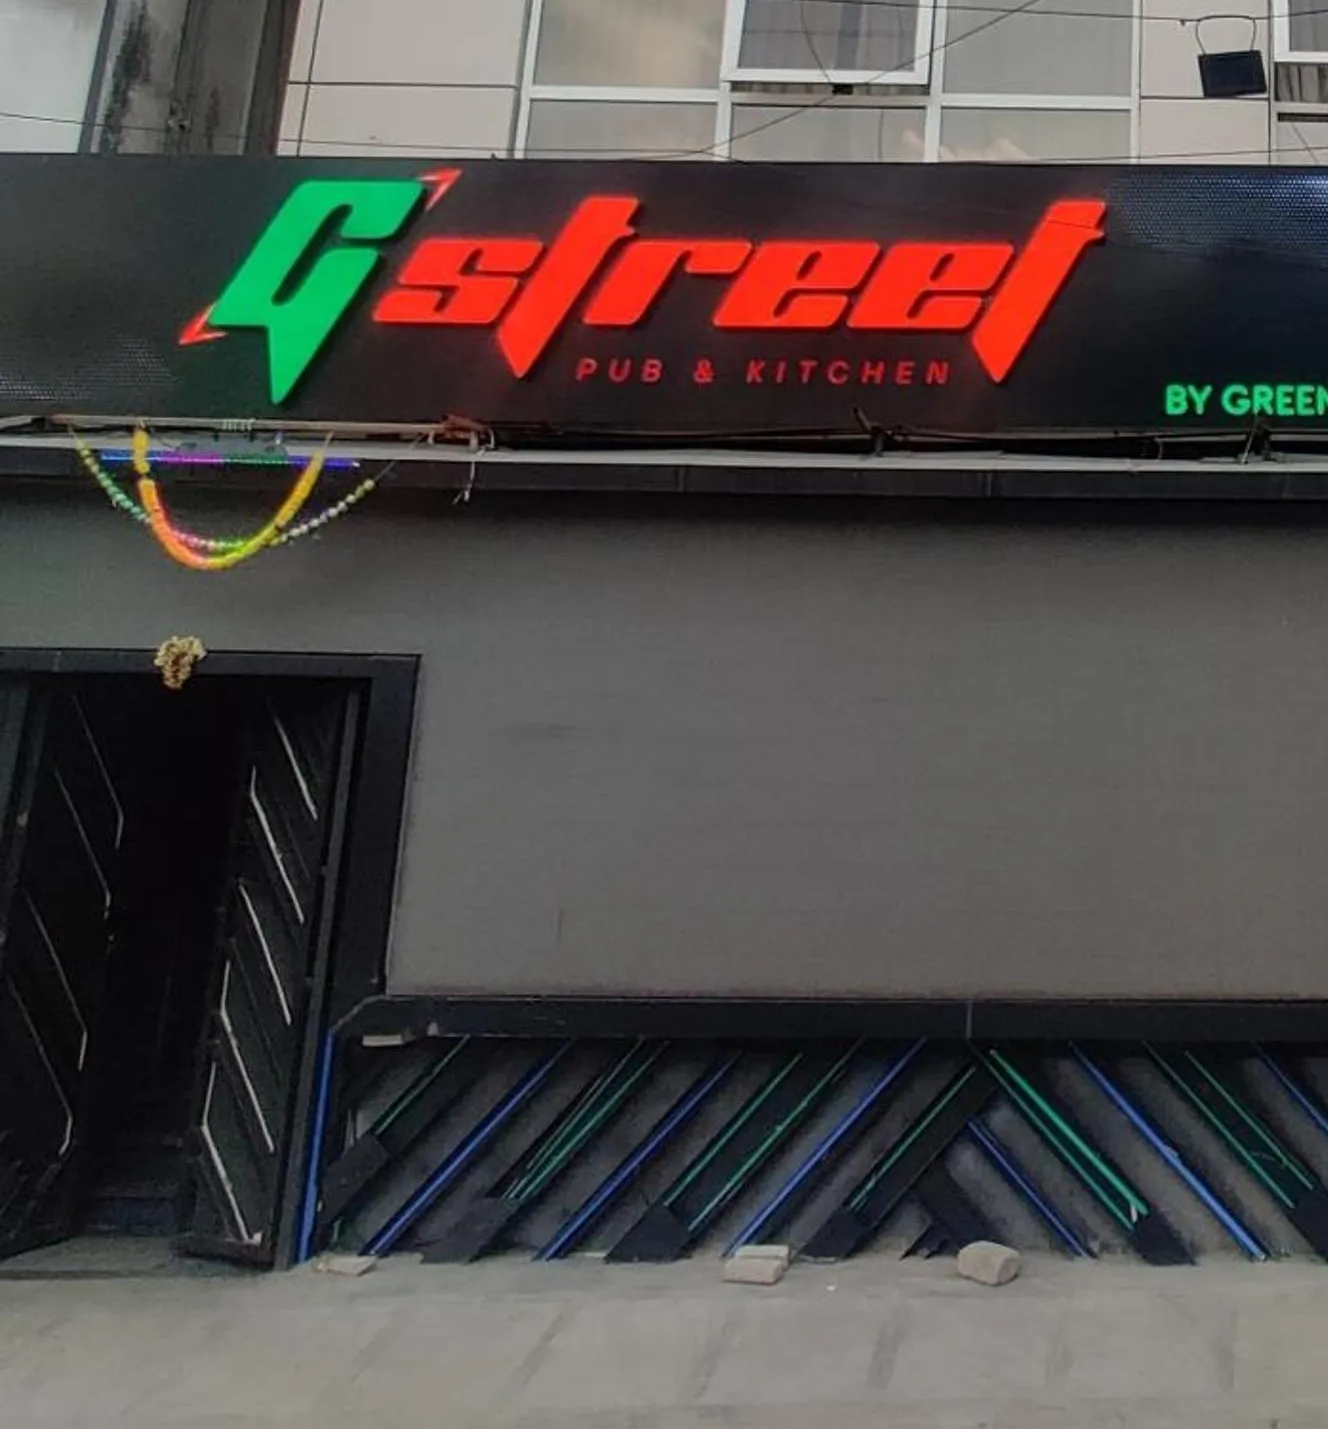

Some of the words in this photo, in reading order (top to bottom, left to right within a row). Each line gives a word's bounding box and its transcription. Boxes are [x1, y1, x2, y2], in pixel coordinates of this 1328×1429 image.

[575, 357, 664, 383] PUB
[692, 359, 716, 384] &
[746, 360, 951, 386] KITCHEN
[1165, 383, 1213, 416] BY
